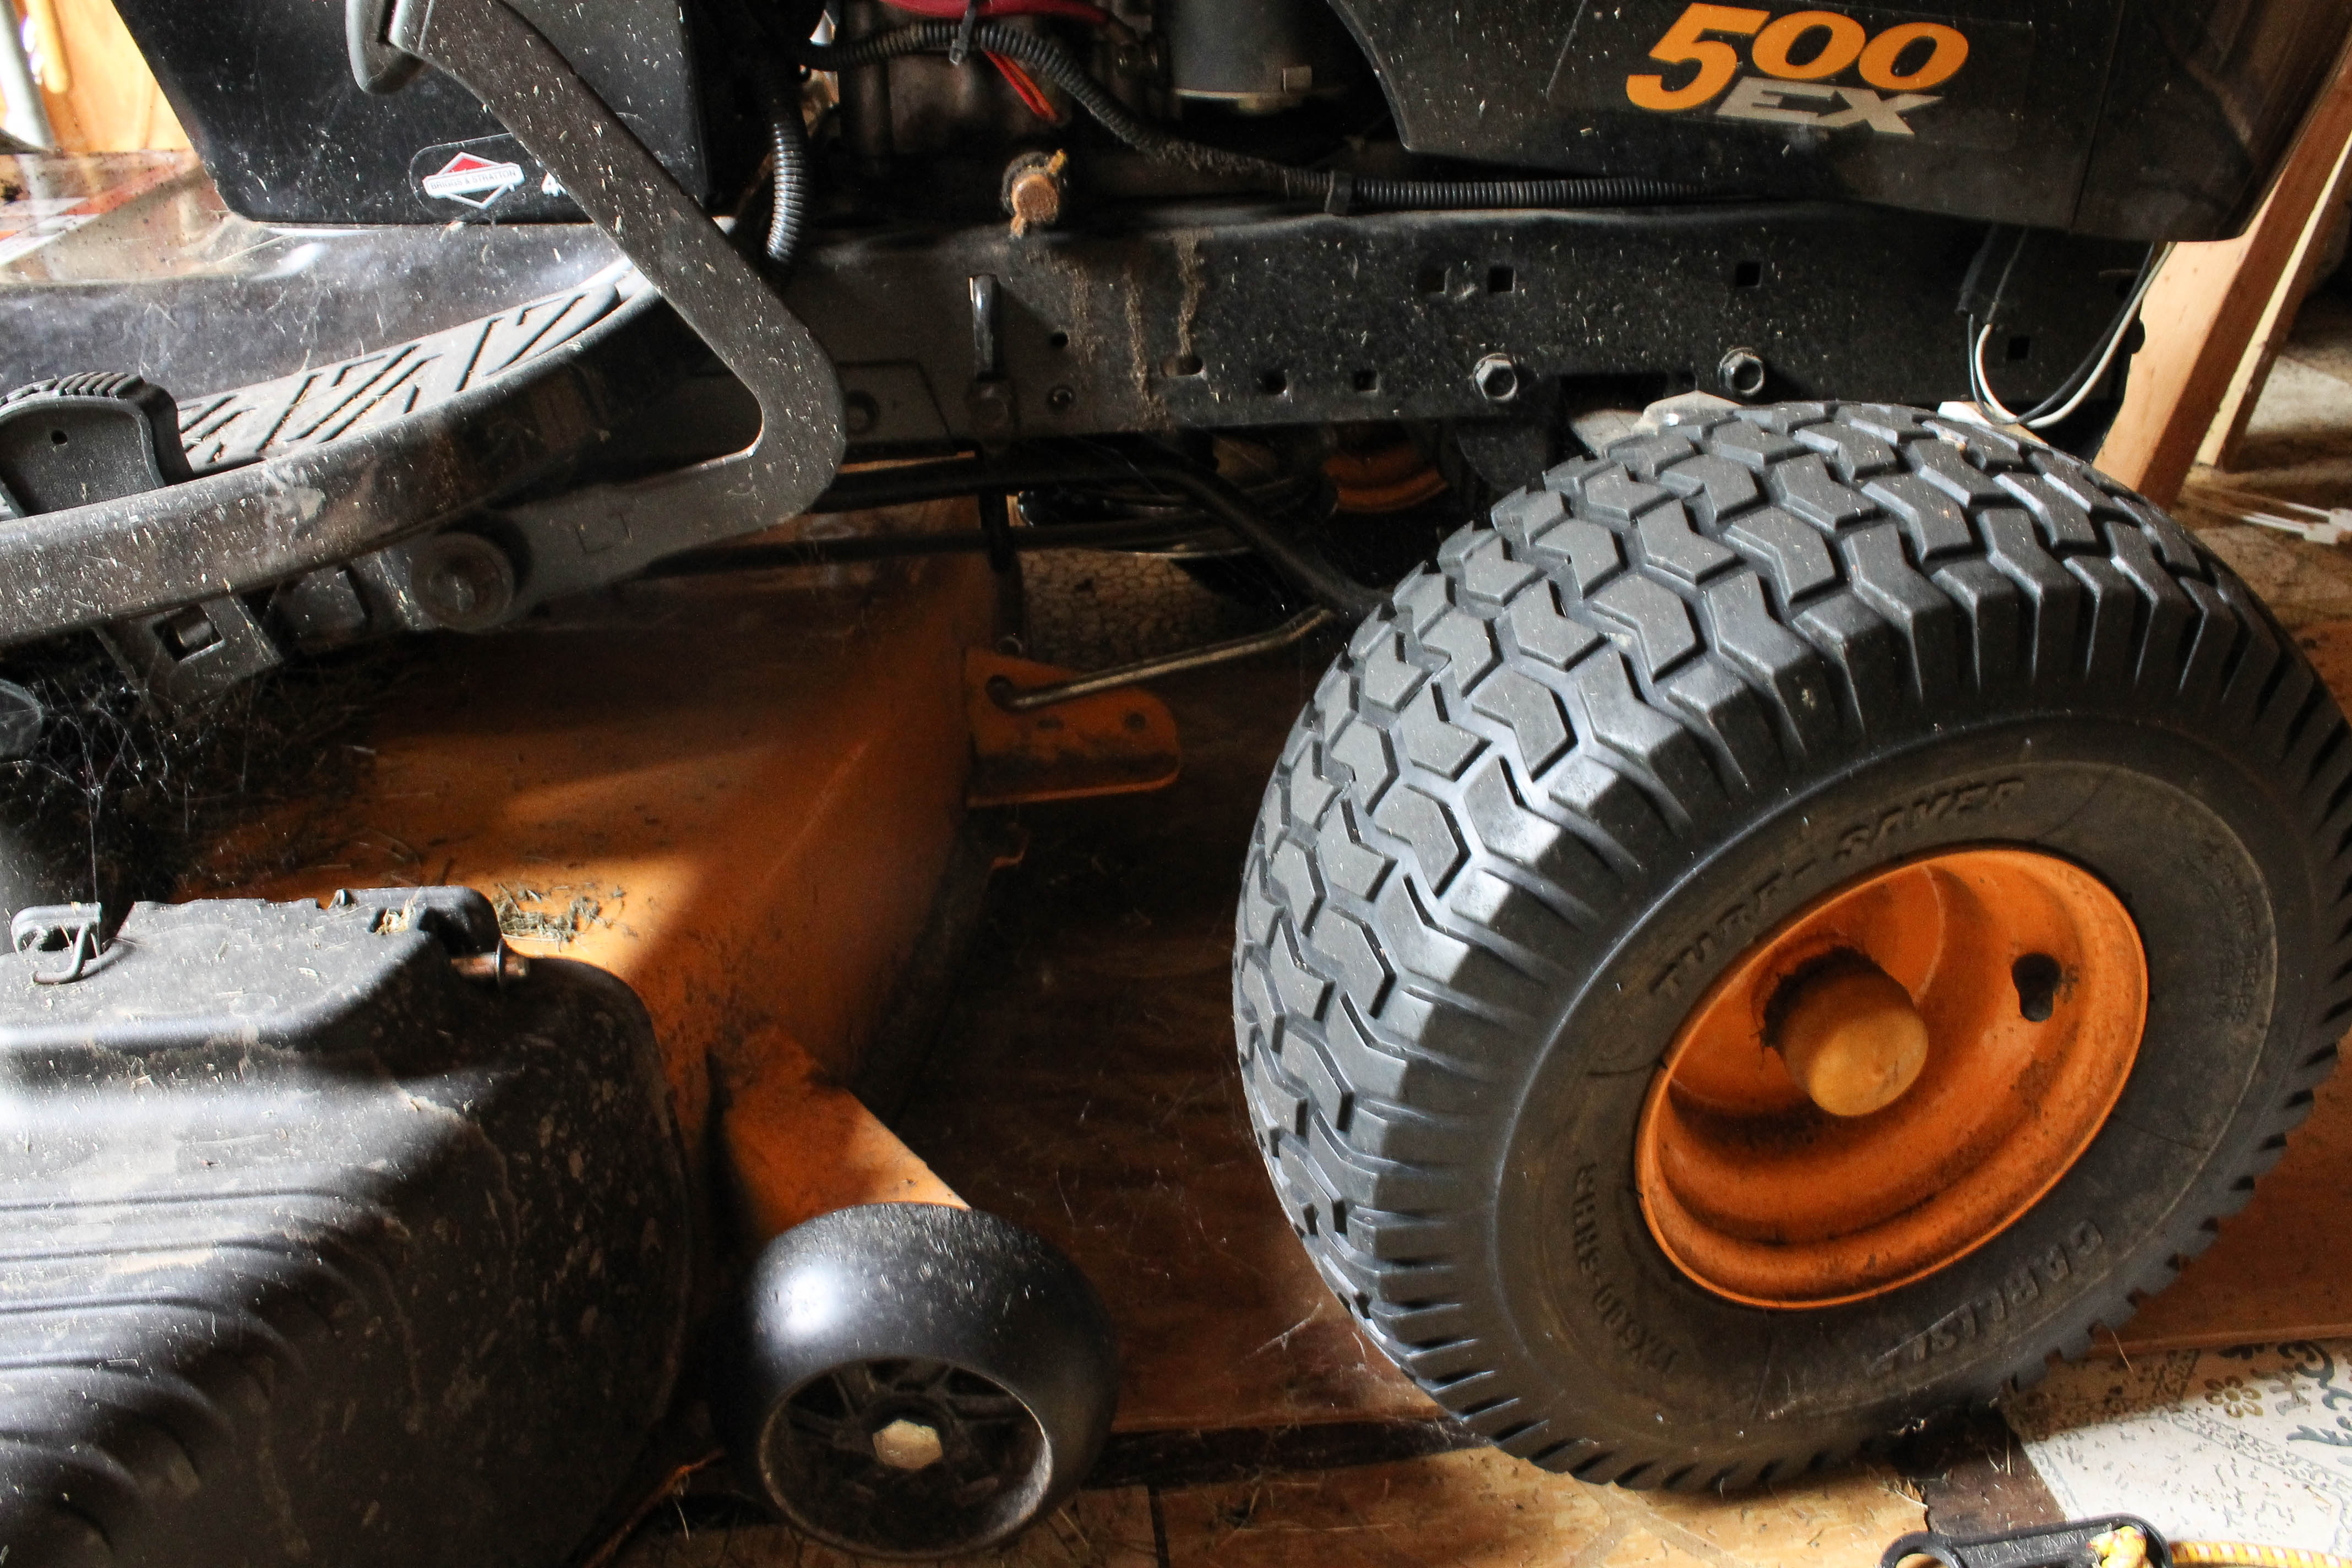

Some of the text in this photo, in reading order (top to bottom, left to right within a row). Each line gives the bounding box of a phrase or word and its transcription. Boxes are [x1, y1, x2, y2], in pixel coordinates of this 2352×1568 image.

[1626, 2, 1969, 112] 500
[1715, 75, 1944, 137] EX
[430, 178, 462, 190] BRIGGS
[472, 169, 516, 183] STRATTON
